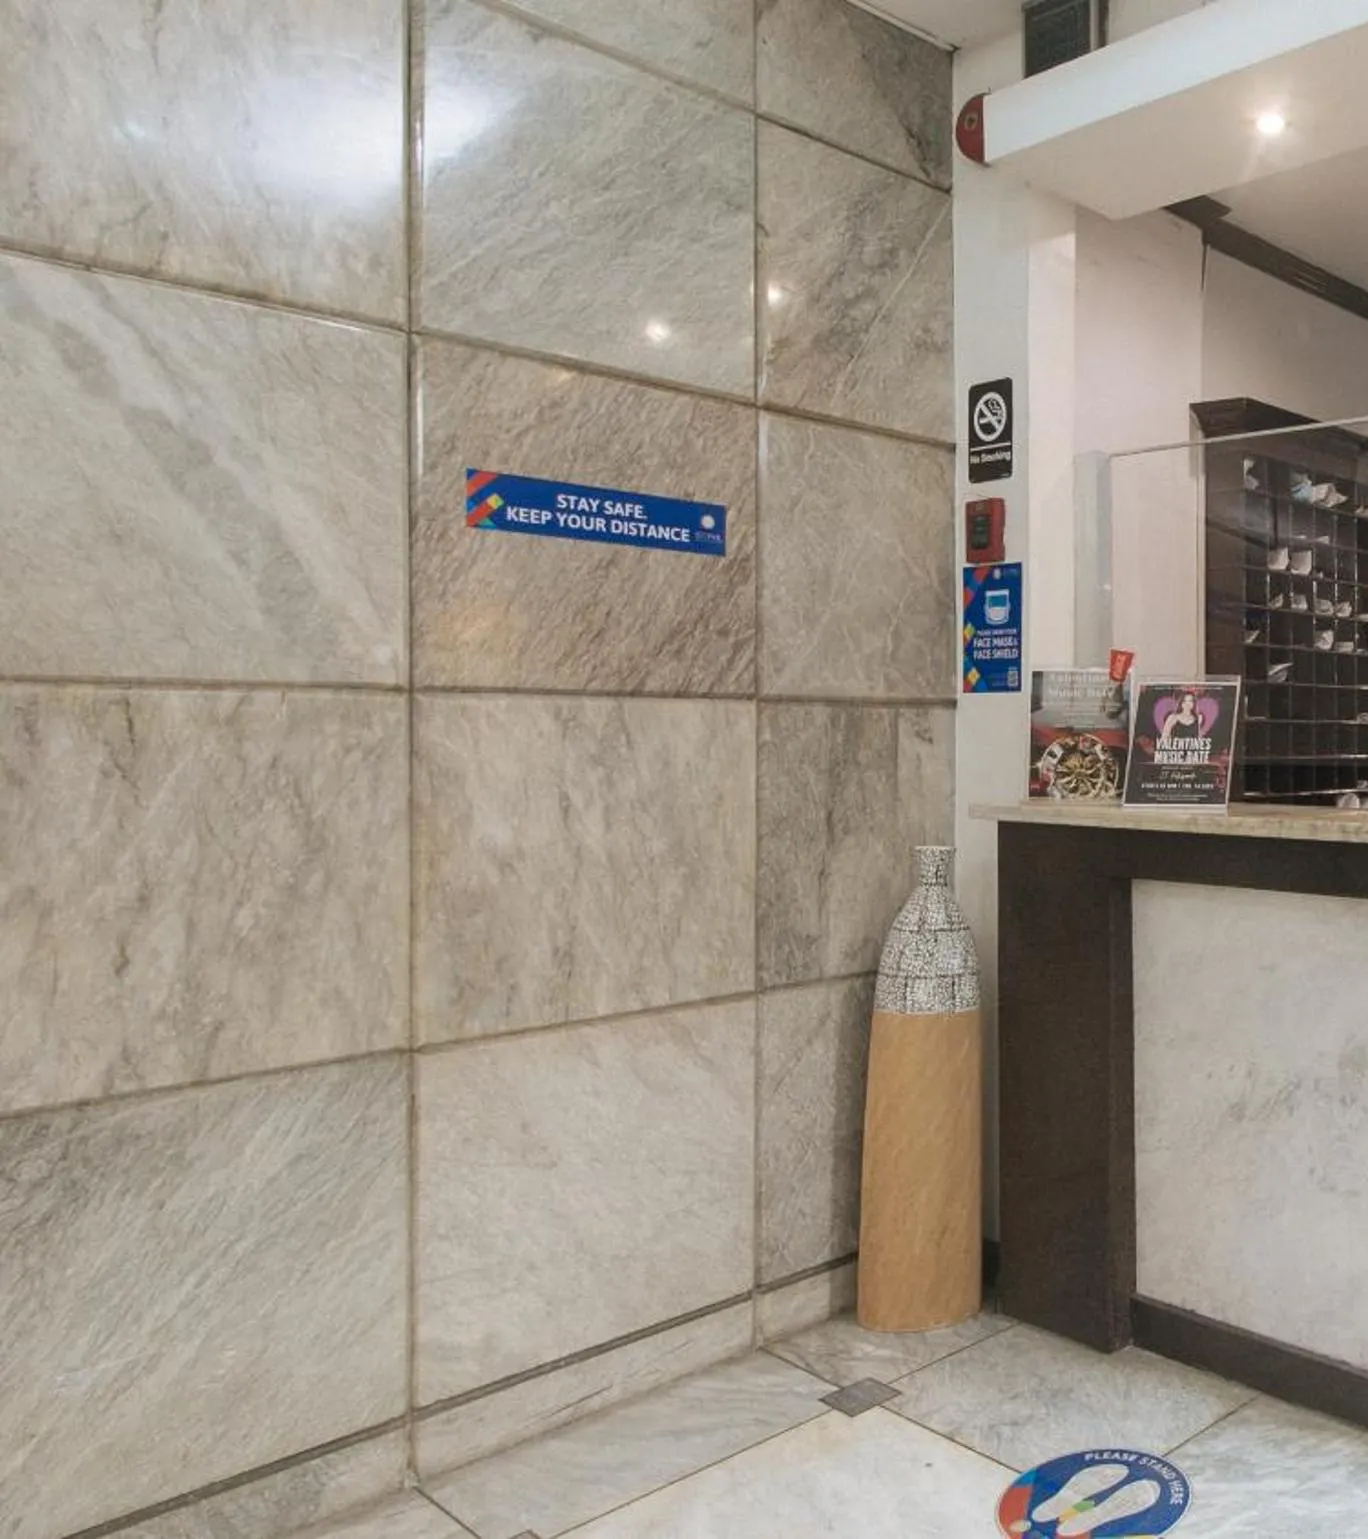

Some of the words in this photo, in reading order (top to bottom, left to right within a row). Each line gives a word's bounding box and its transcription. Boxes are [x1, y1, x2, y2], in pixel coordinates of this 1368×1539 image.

[556, 494, 600, 513] STAY
[604, 500, 648, 520] SAFE.
[506, 506, 552, 525] KEEP
[557, 511, 607, 532] YOUR
[610, 520, 691, 543] DISTANCE
[973, 637, 991, 649] FACE
[973, 649, 991, 661] FACE
[1156, 736, 1212, 750] VALENTINES
[1154, 750, 1185, 765] MUSIC
[1186, 750, 1210, 765] DATE
[1084, 1451, 1138, 1463] PLEASE
[1139, 1454, 1177, 1482] STAND
[1168, 1479, 1184, 1505] HERE
